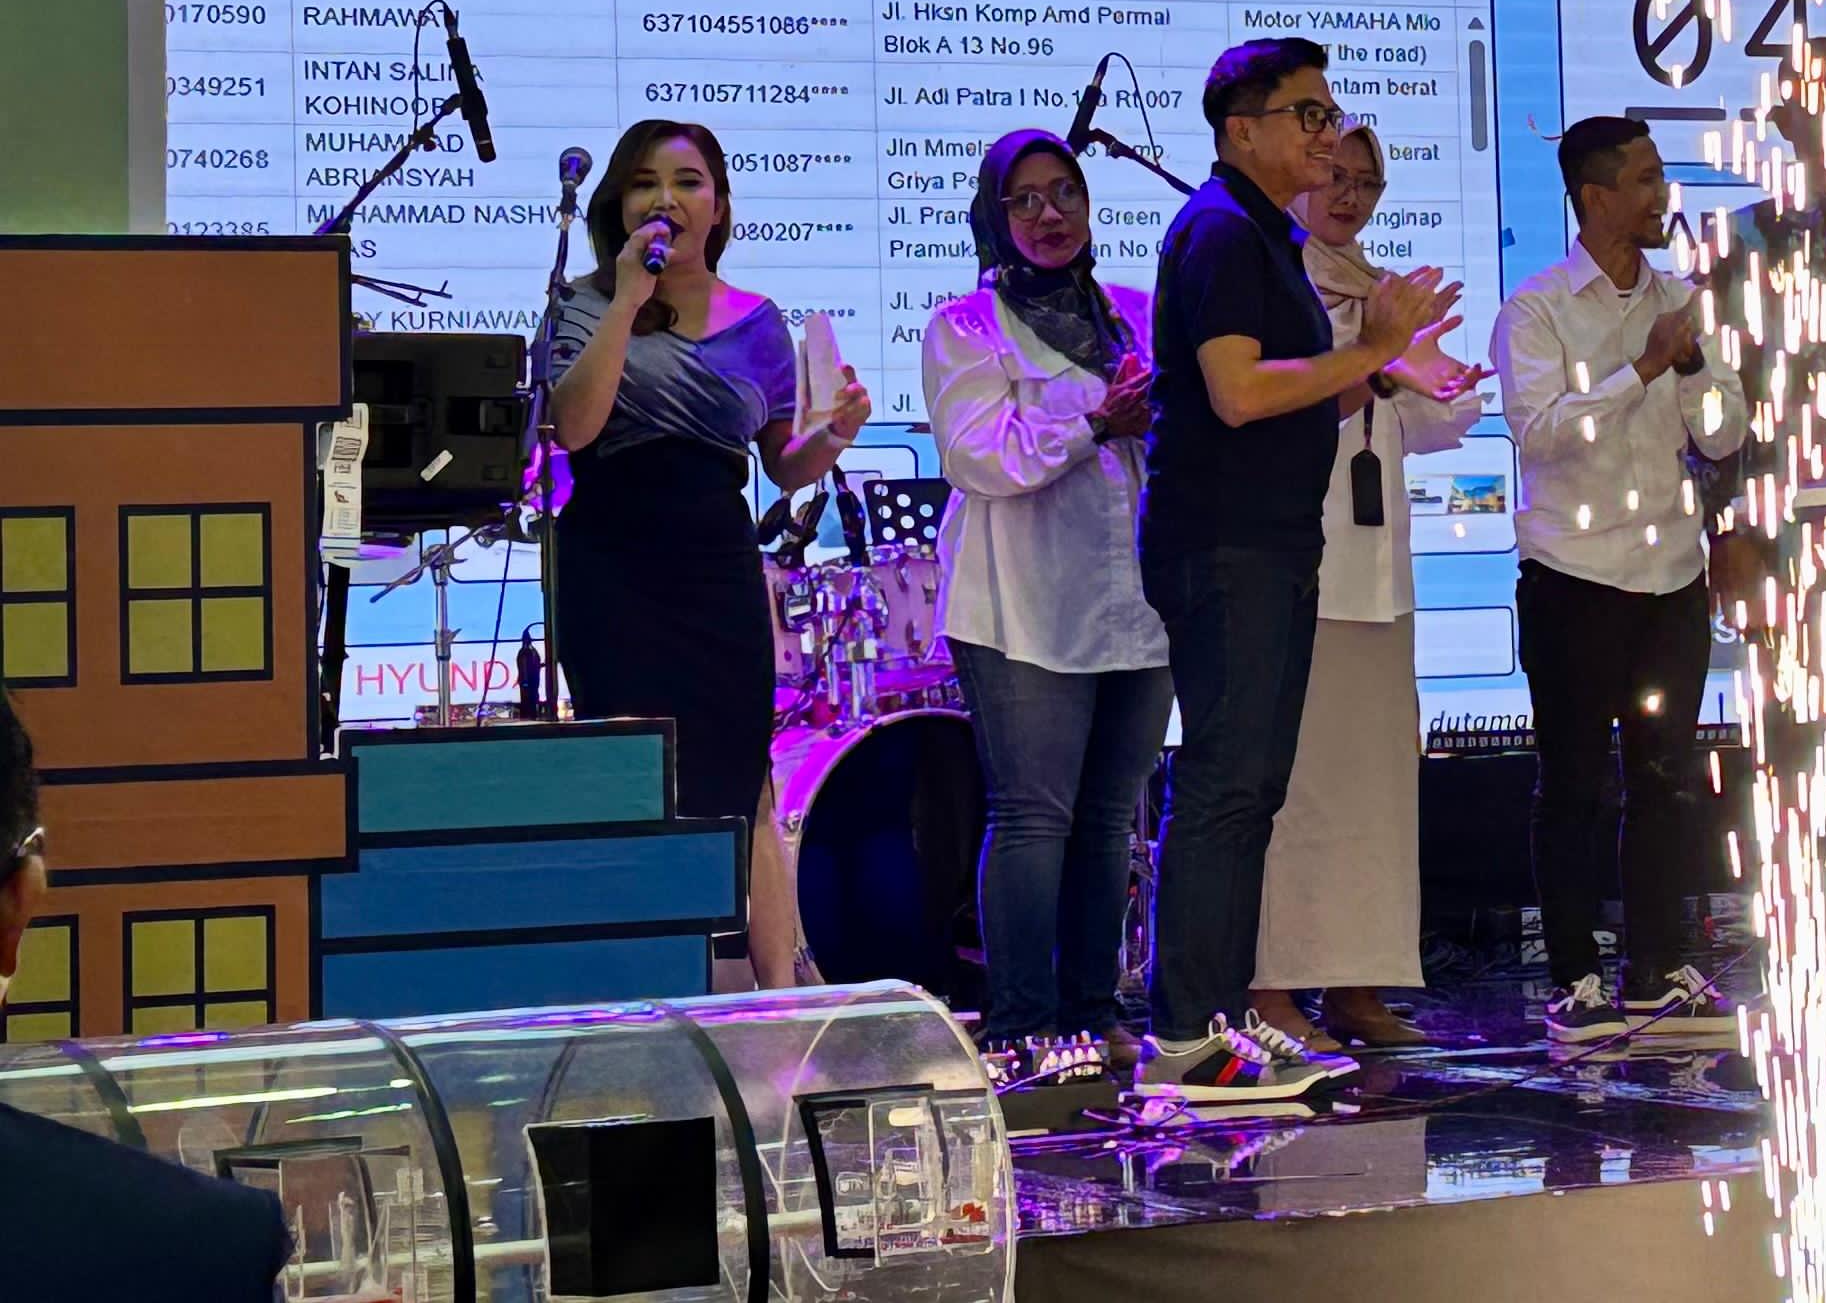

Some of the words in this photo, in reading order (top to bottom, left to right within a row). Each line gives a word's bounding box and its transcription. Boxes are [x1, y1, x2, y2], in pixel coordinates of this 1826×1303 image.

[975, 3, 1037, 27] Komp
[1306, 11, 1401, 31] YAMAHA
[883, 35, 930, 54] Blok
[936, 37, 953, 54] A
[959, 37, 984, 54] 13
[1375, 45, 1427, 66] road)
[304, 60, 381, 81] INTAN
[356, 659, 520, 696] HYUND
[1430, 709, 1528, 732] dutama
